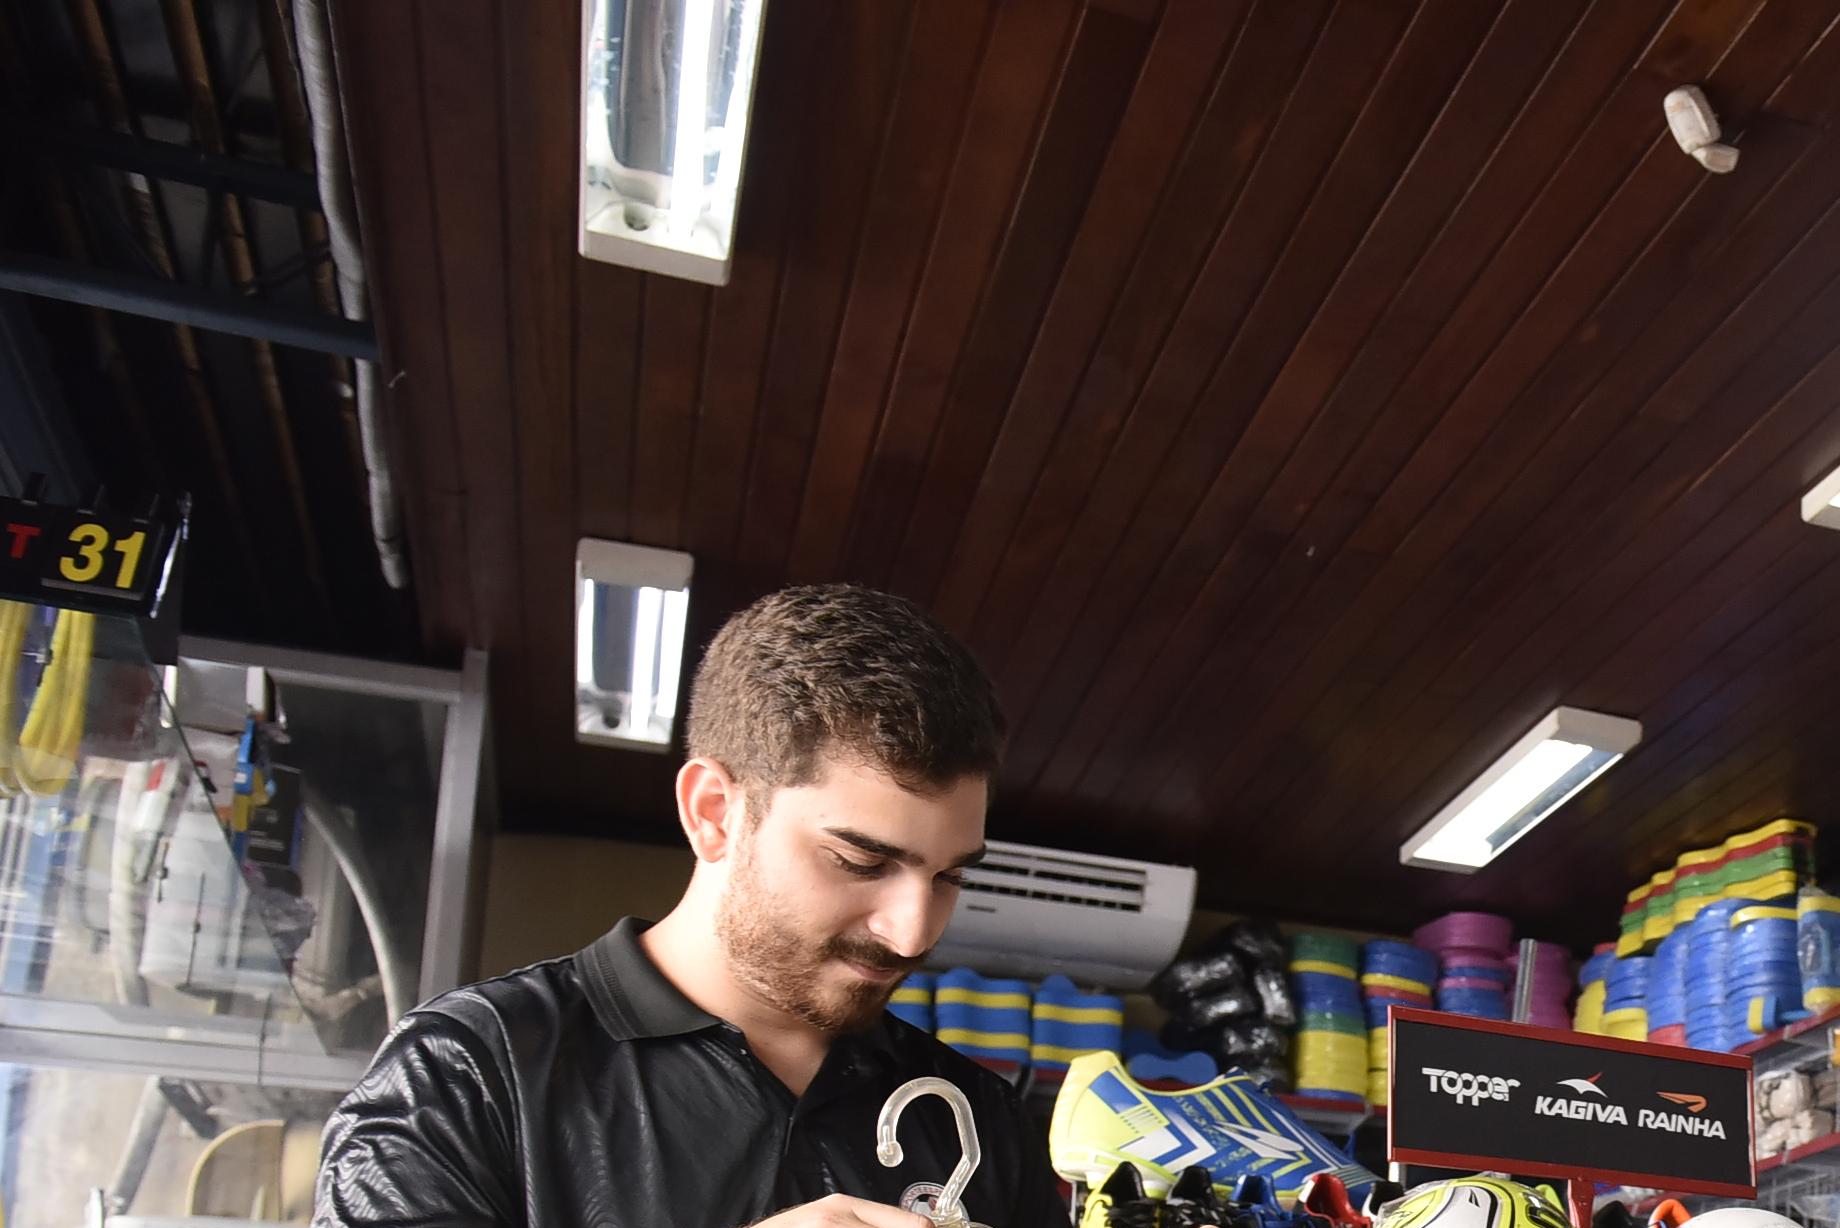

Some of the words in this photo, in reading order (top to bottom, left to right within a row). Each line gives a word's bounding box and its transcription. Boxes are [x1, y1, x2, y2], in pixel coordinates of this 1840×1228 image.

[59, 522, 147, 590] 31
[1534, 1095, 1628, 1126] KAGIVA
[1638, 1109, 1726, 1140] RAINHA
